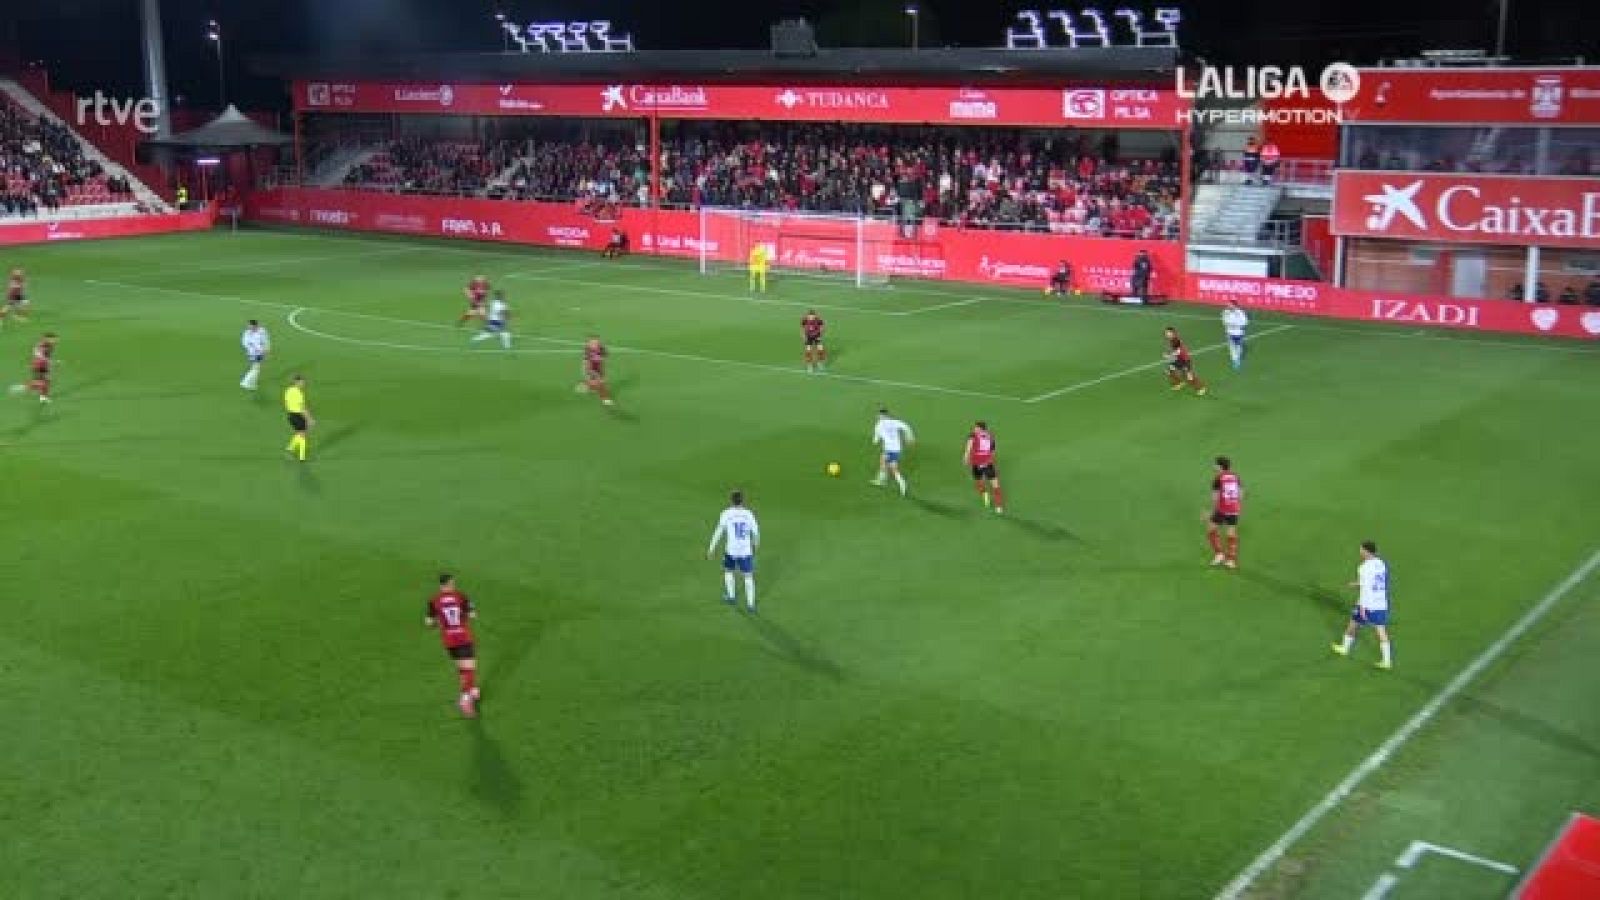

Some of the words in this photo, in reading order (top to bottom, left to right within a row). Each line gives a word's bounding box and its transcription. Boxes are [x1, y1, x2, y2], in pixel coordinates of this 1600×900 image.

[807, 92, 889, 109] TUDANCA
[1373, 299, 1480, 326] IZADI
[442, 607, 460, 625] 17
